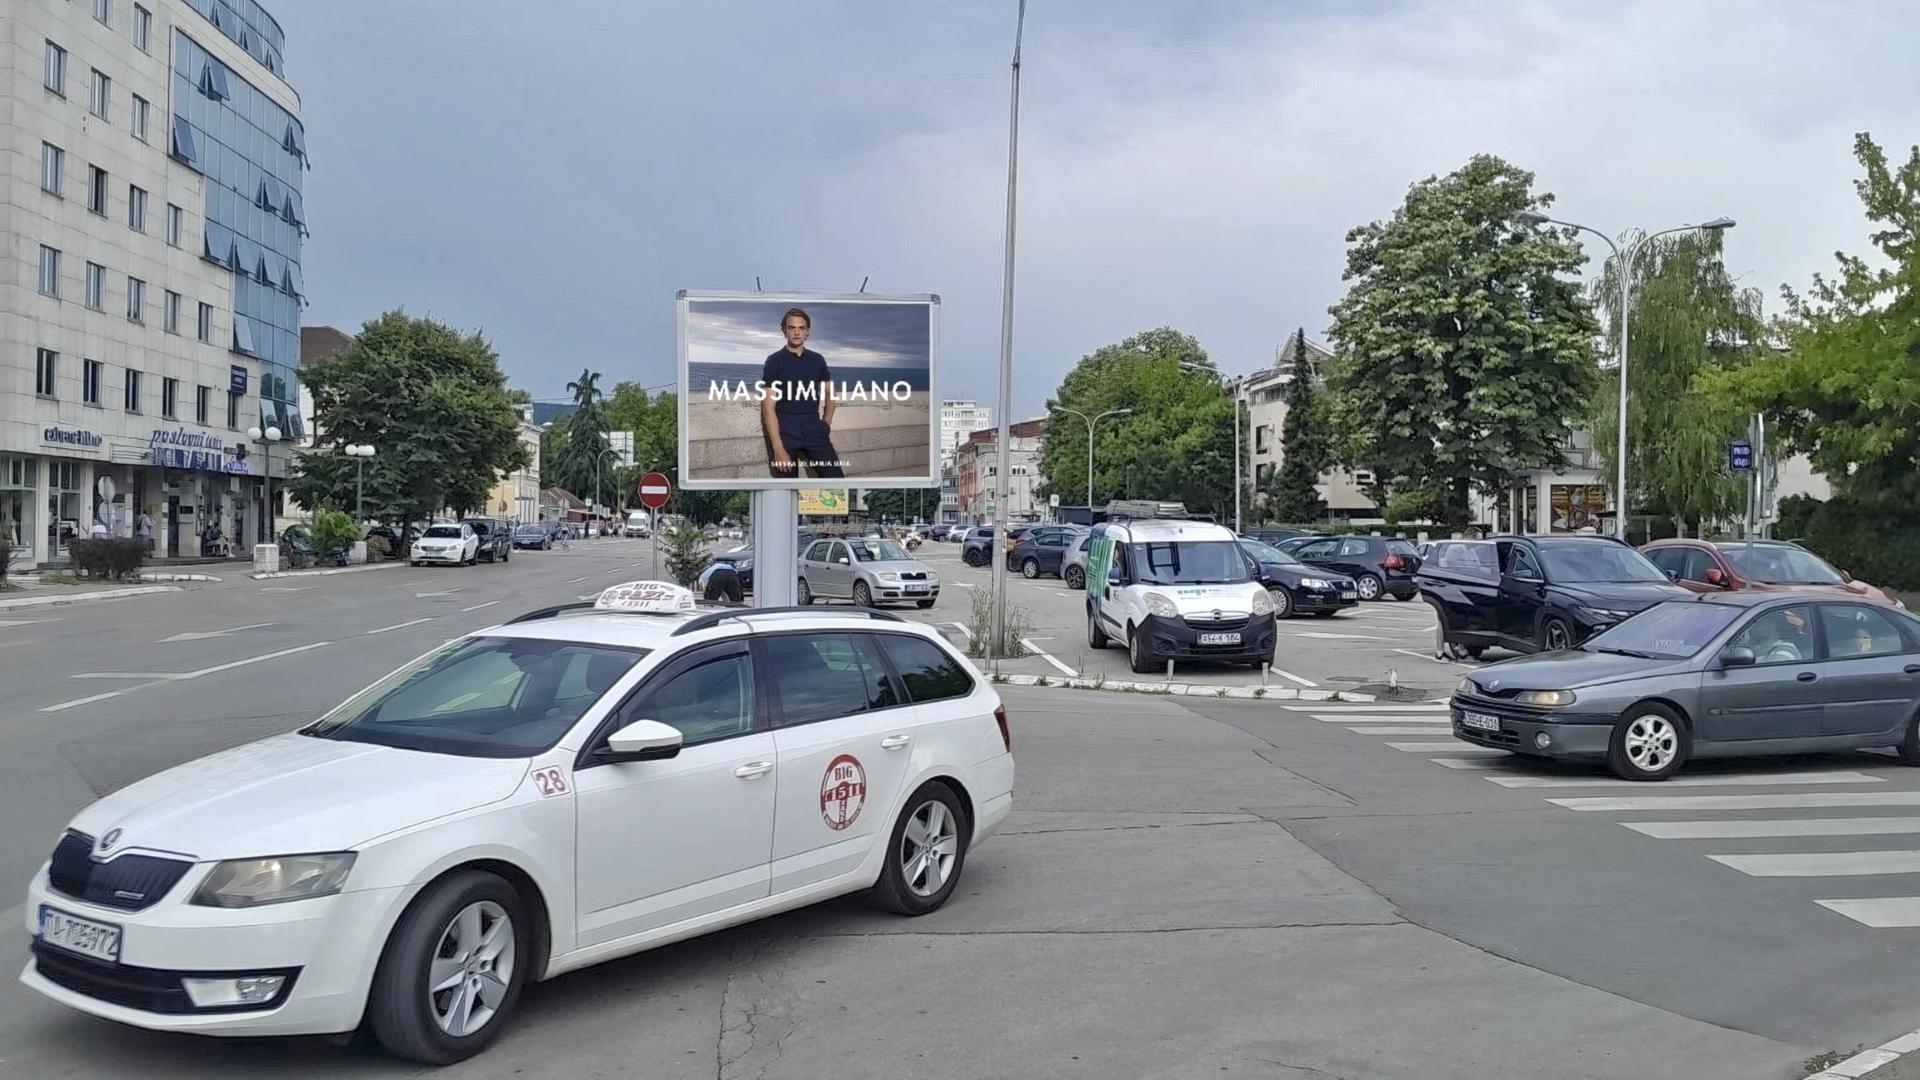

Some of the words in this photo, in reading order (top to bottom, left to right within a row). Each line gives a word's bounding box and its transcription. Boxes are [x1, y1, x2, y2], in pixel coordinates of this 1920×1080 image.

[708, 379, 912, 402] MASSIMILIANO
[535, 769, 566, 795] 28
[834, 766, 852, 780] BIG
